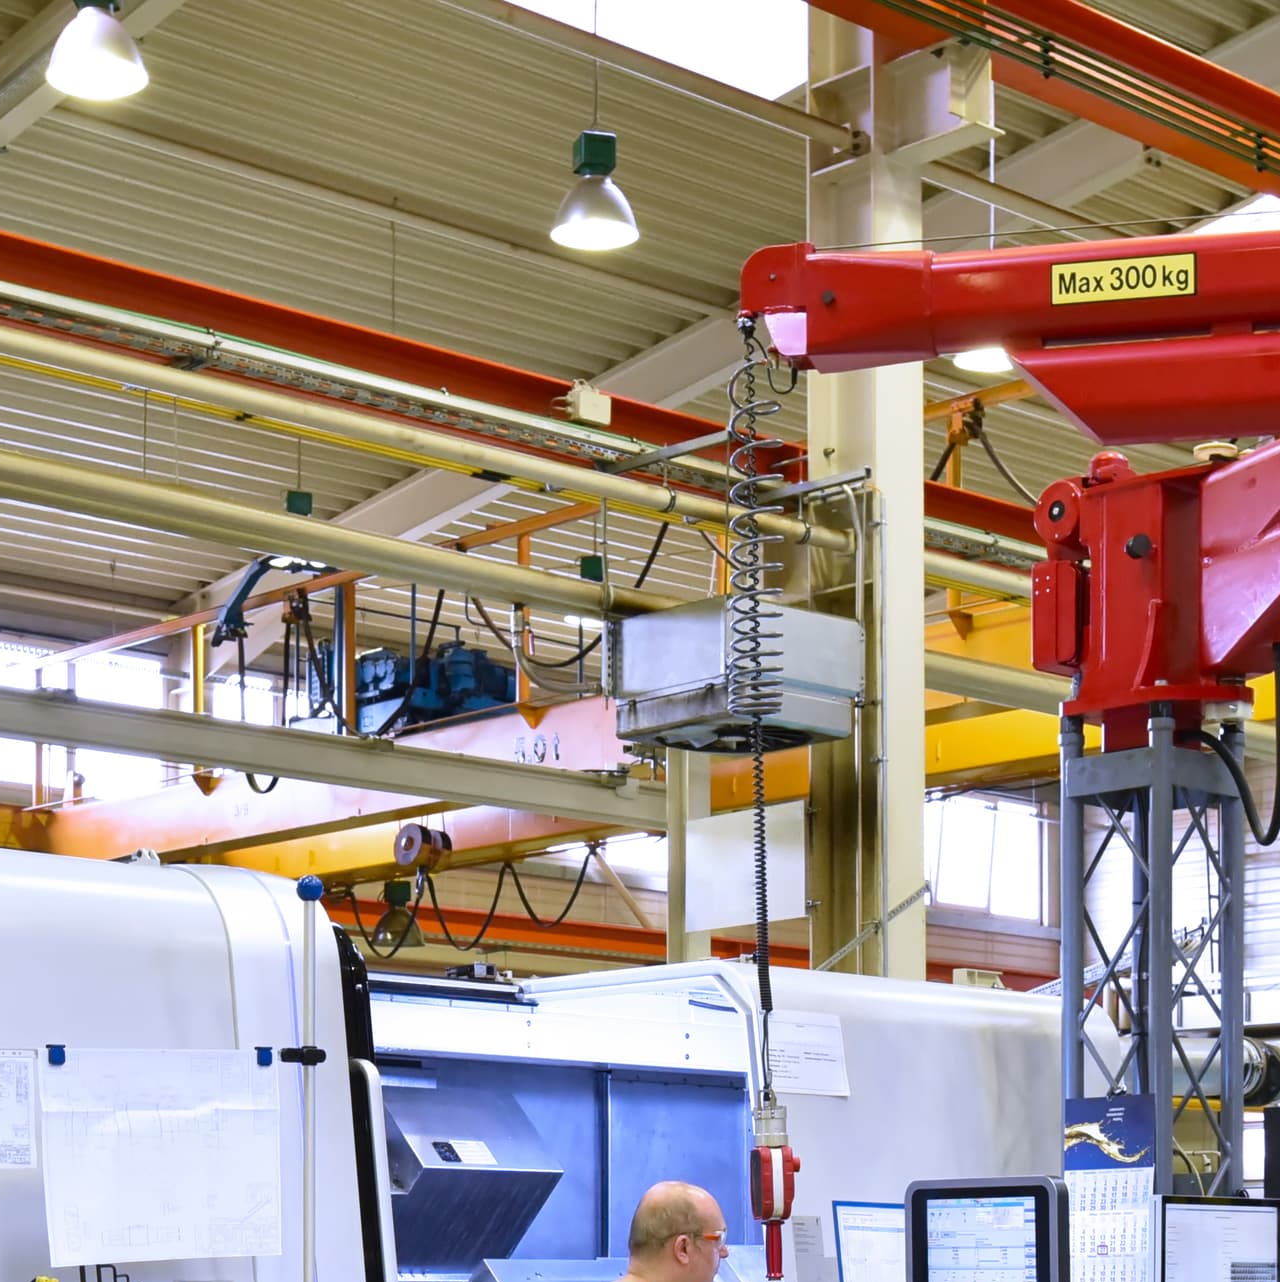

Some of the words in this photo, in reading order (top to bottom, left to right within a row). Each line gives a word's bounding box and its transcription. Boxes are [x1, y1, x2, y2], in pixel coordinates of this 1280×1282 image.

[1058, 272, 1104, 295] Max
[1110, 264, 1157, 291] 300
[1162, 265, 1189, 291] kg
